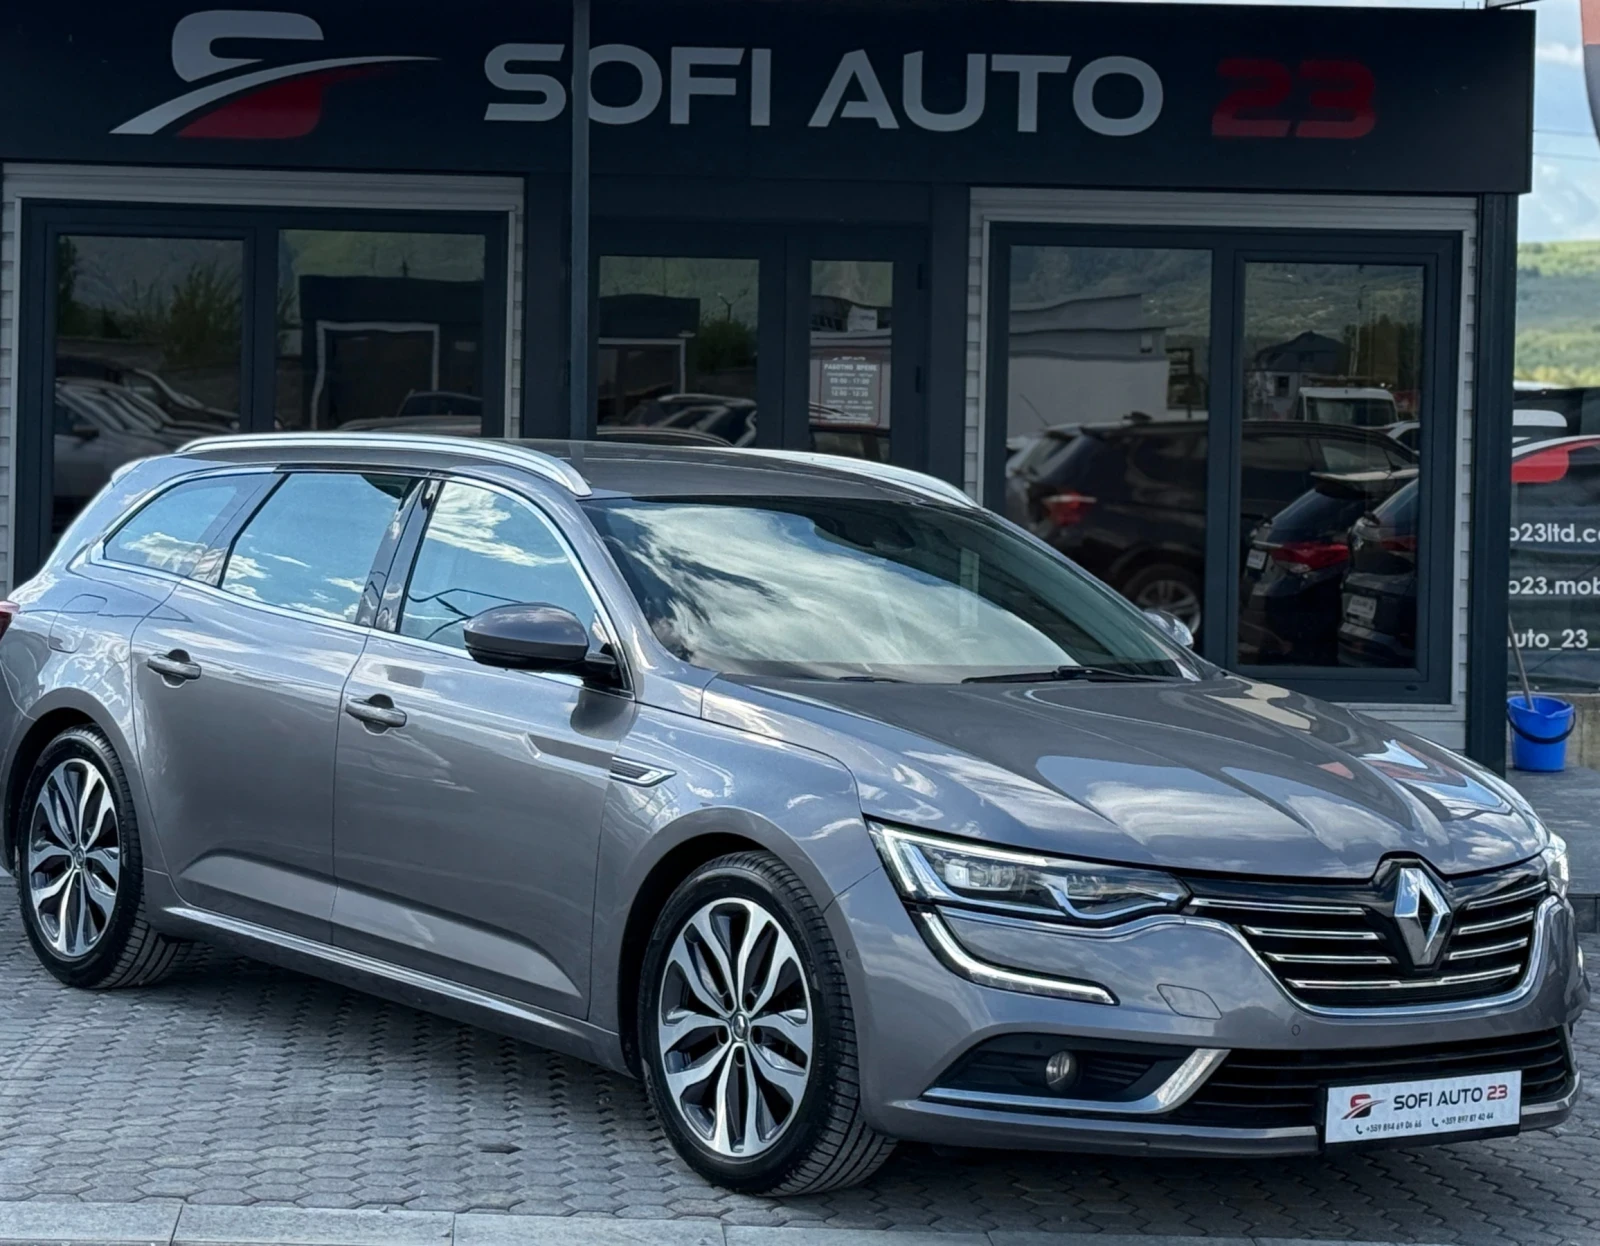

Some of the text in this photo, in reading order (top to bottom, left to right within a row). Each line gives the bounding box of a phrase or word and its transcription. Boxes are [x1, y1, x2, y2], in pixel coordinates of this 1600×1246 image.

[484, 43, 1376, 139] SOFI AUTO 23
[1509, 523, 1600, 543] o23ltd.c
[1393, 1084, 1508, 1111] SOFI AUTO 23
